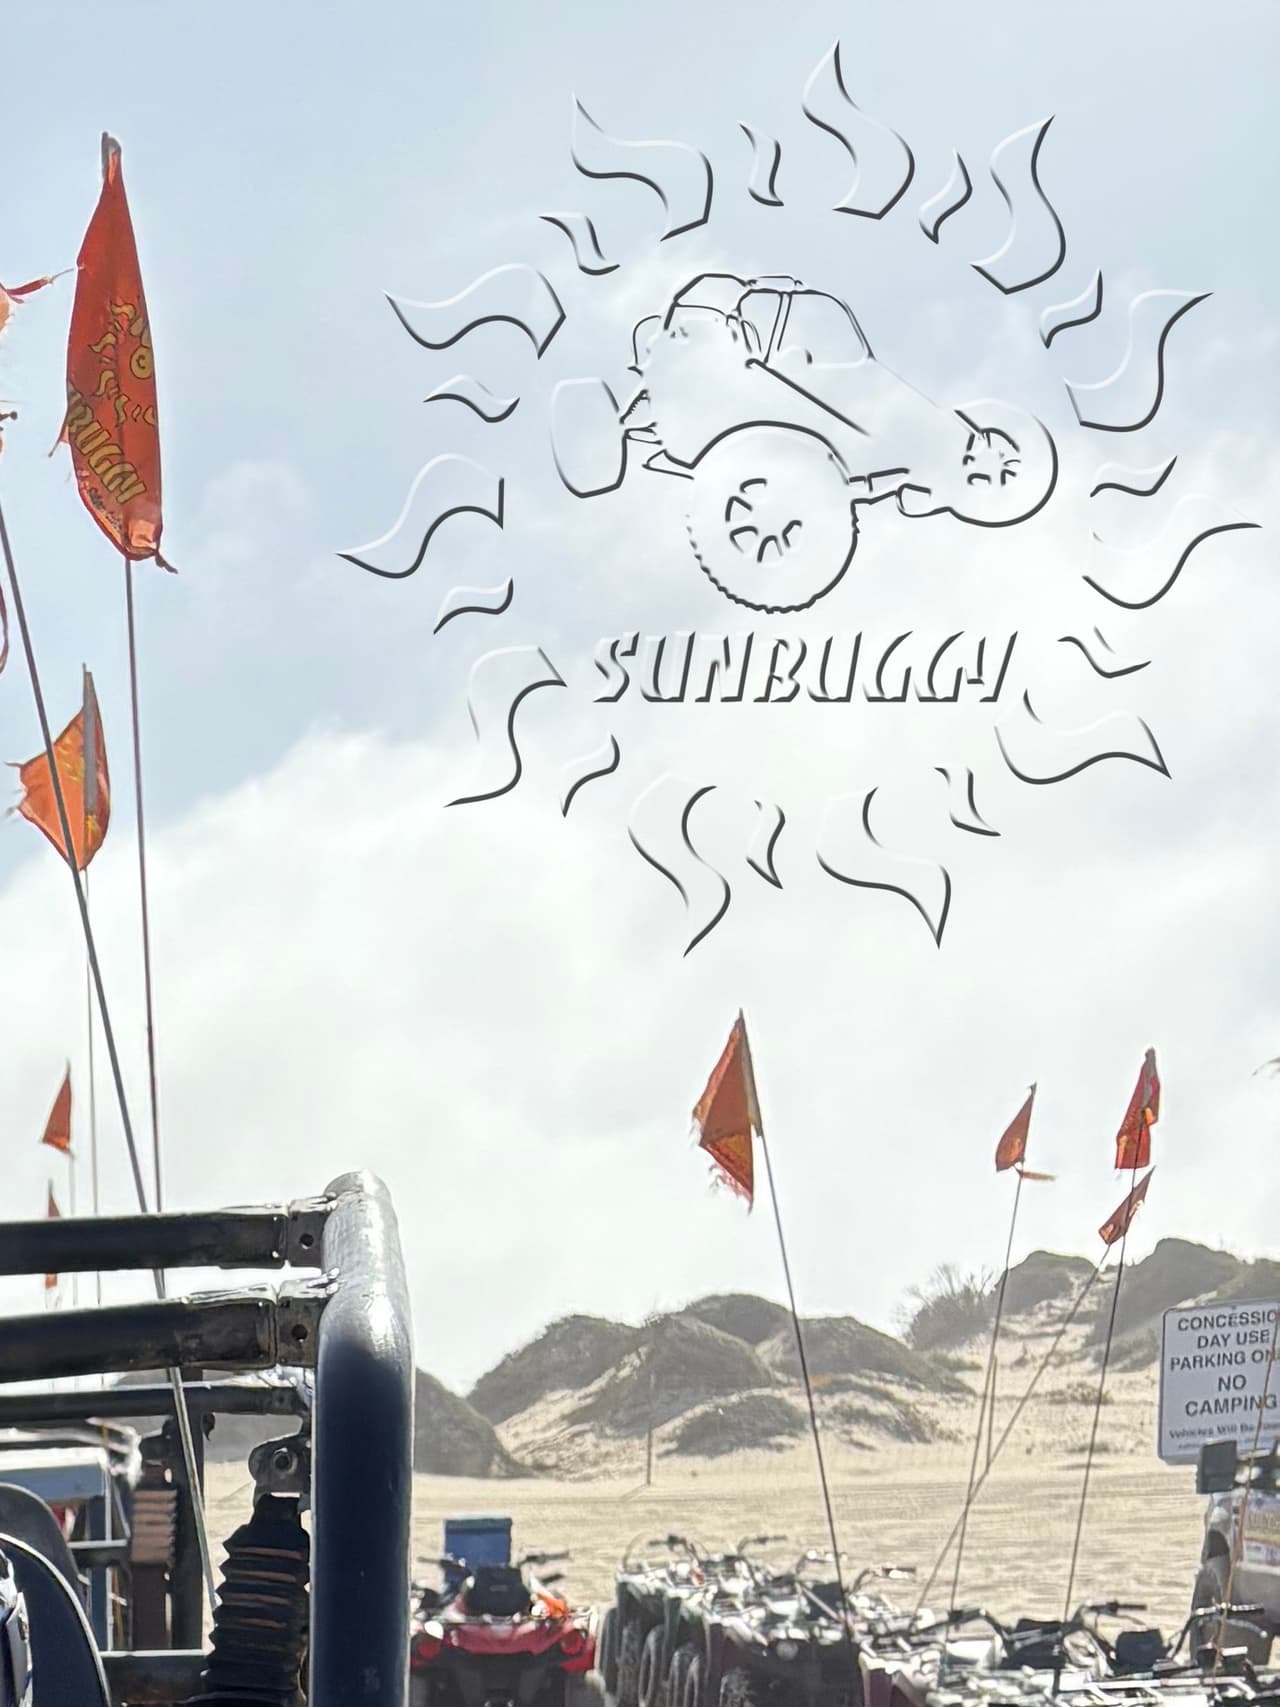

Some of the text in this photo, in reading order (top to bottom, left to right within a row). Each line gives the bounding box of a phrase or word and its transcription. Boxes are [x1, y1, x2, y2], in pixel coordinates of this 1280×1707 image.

[1178, 1310, 1279, 1331] CONCESSIO
[1197, 1328, 1270, 1349] DAY USE
[1170, 1350, 1246, 1371] PARKING
[1218, 1374, 1247, 1392] NO
[1185, 1393, 1278, 1417] CAMPING
